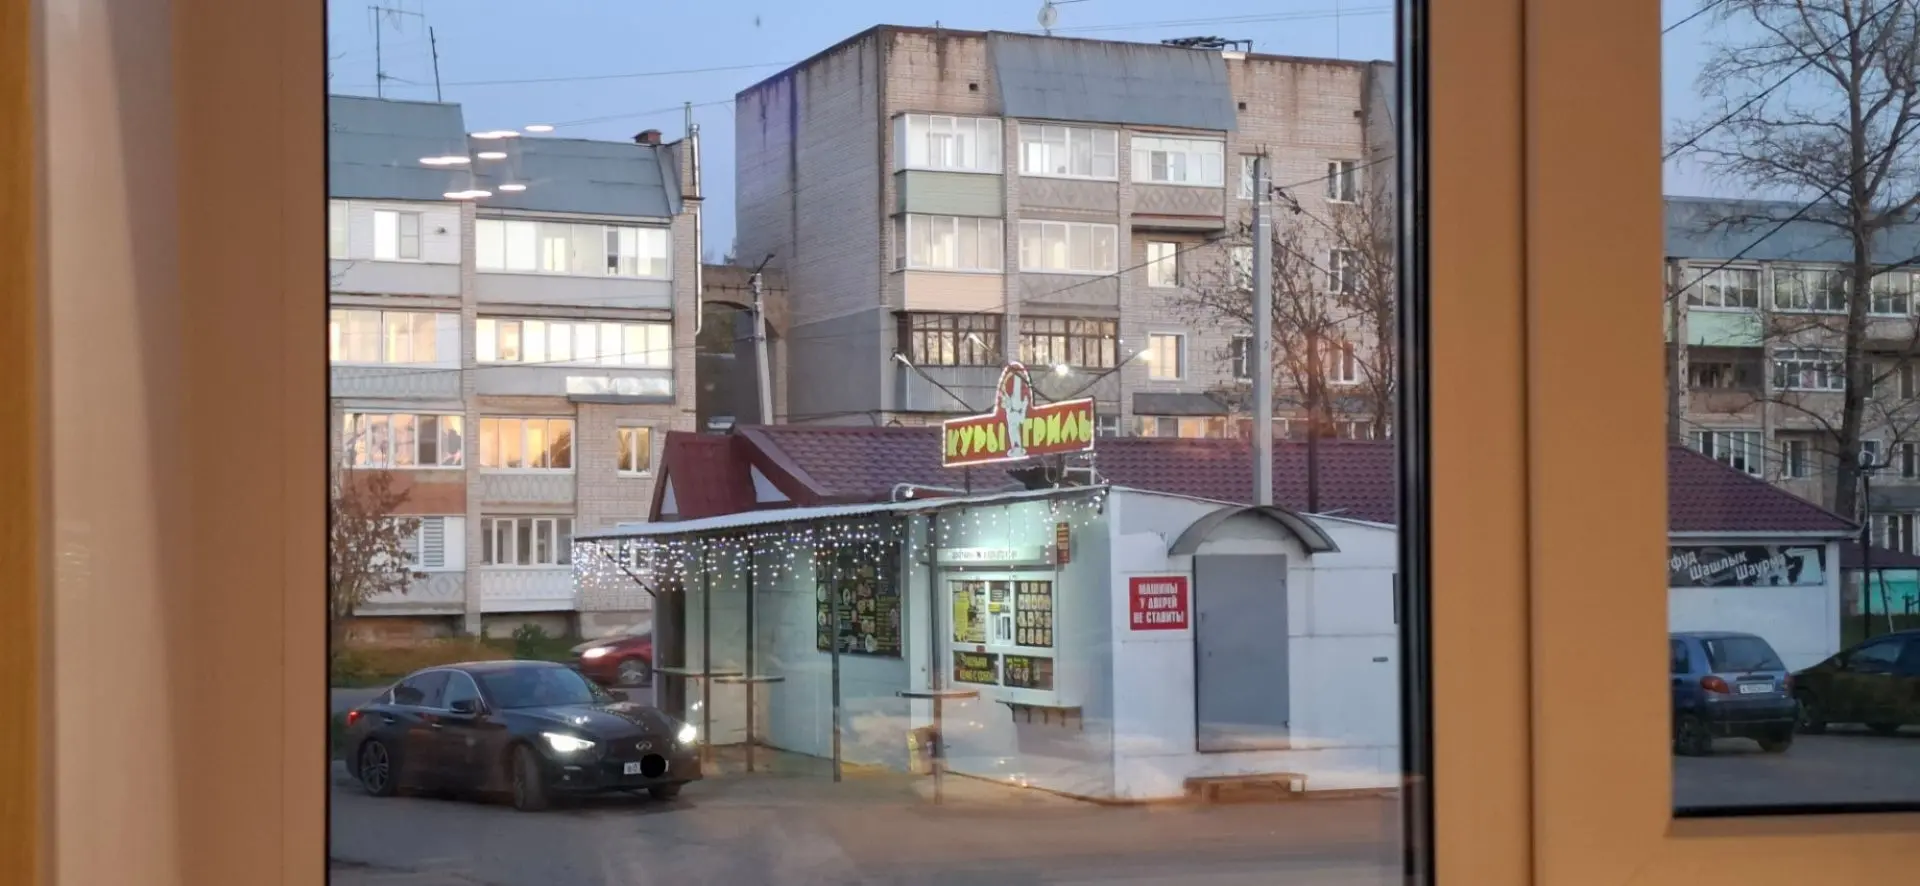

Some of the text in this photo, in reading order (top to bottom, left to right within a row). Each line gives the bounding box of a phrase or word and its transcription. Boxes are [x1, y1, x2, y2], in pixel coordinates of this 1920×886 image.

[947, 410, 1092, 457] КУРЫ ГРИЛЬ
[1667, 551, 1698, 572] фуд
[1690, 551, 1748, 580] Шашлык
[1735, 553, 1787, 581] Шаурма
[1138, 583, 1178, 595] МАШИНЫ
[1139, 595, 1178, 609] У ДВЕРЕЙ
[1133, 612, 1144, 623] НЕ
